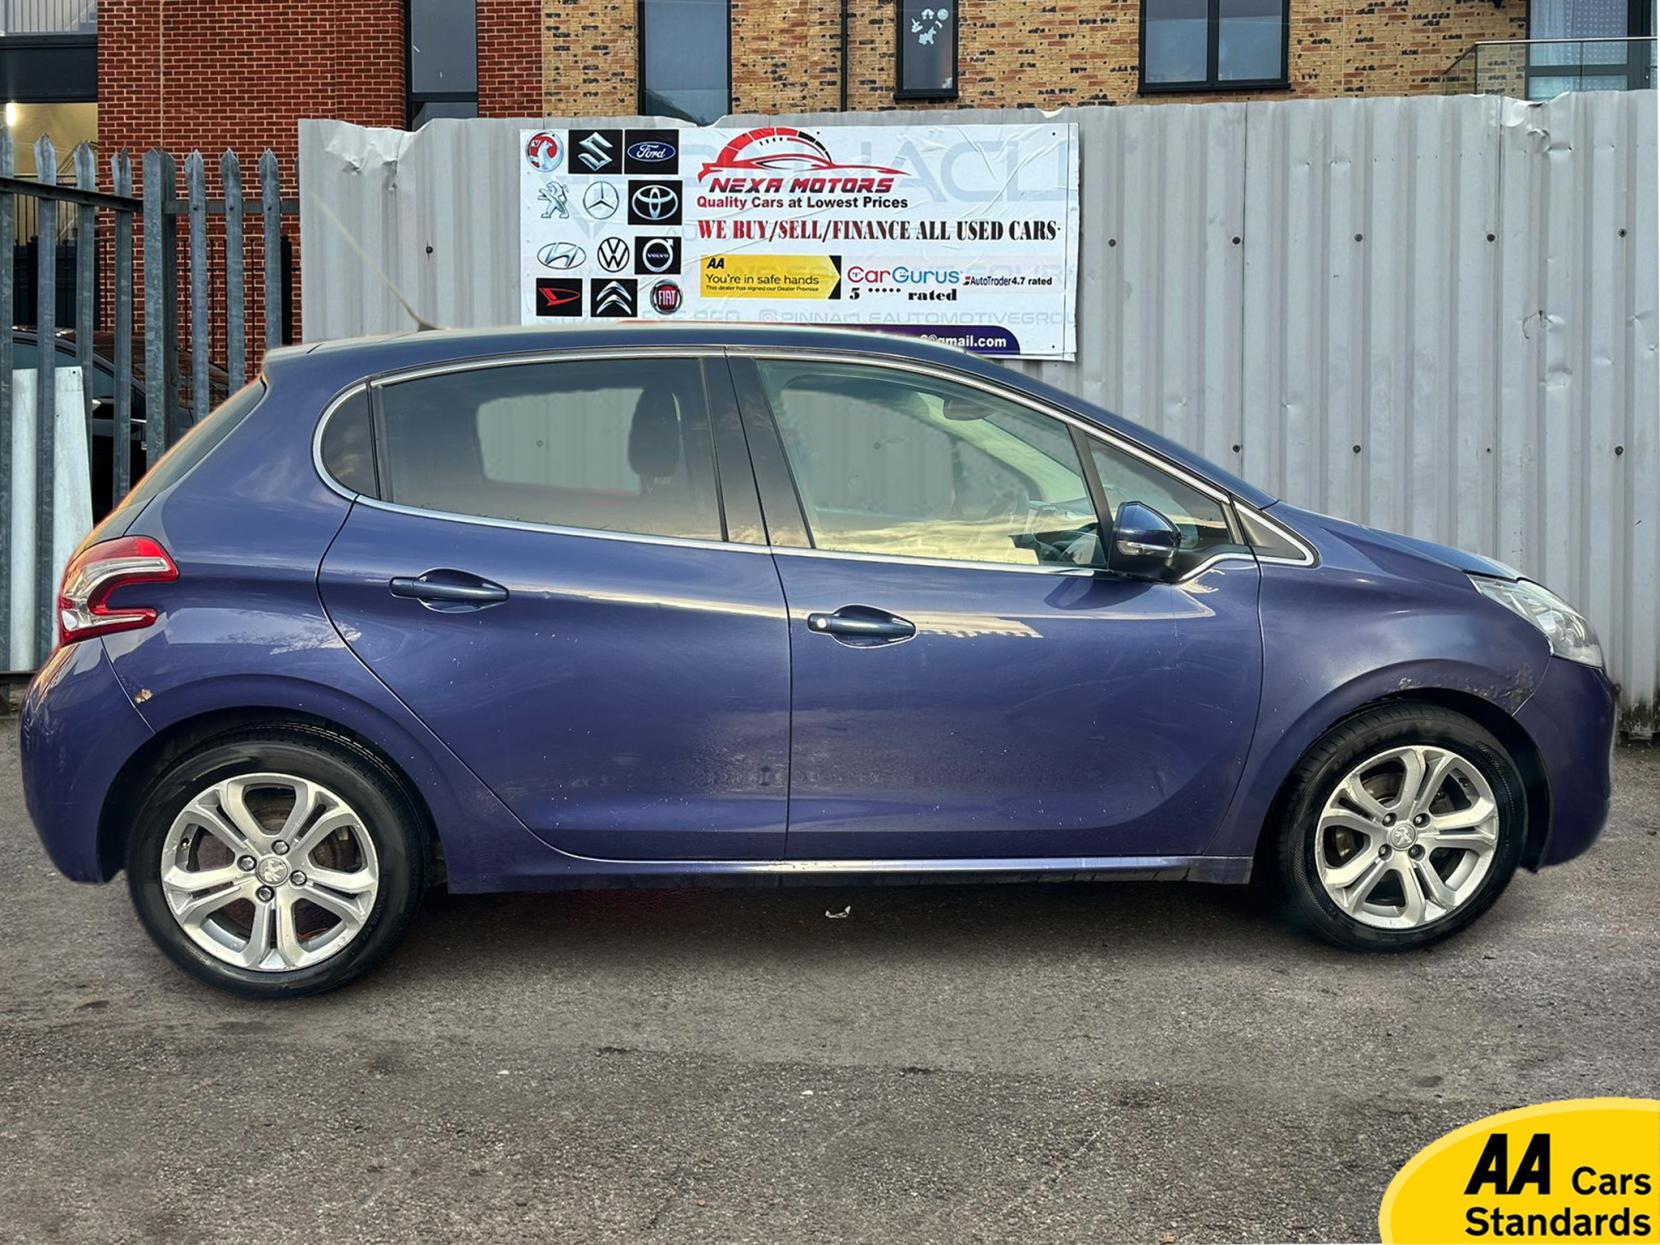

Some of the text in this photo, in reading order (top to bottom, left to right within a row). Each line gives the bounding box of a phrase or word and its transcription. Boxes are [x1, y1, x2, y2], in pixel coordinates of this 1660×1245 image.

[636, 144, 665, 158] Ford
[709, 178, 894, 193] NEXA MOTORS
[697, 196, 908, 210] Quality Cars at Lowest Prices
[698, 220, 726, 239] WE
[733, 219, 910, 242] BUY/SELL/FINANCE
[917, 220, 950, 240] ALL
[957, 220, 1003, 240] USED
[707, 257, 725, 269] AA
[706, 273, 819, 285] You're in safe hands
[847, 266, 959, 284] CarGurus
[1028, 276, 1052, 285] rated
[658, 290, 676, 305] FIAT
[849, 287, 957, 301] 5 rated
